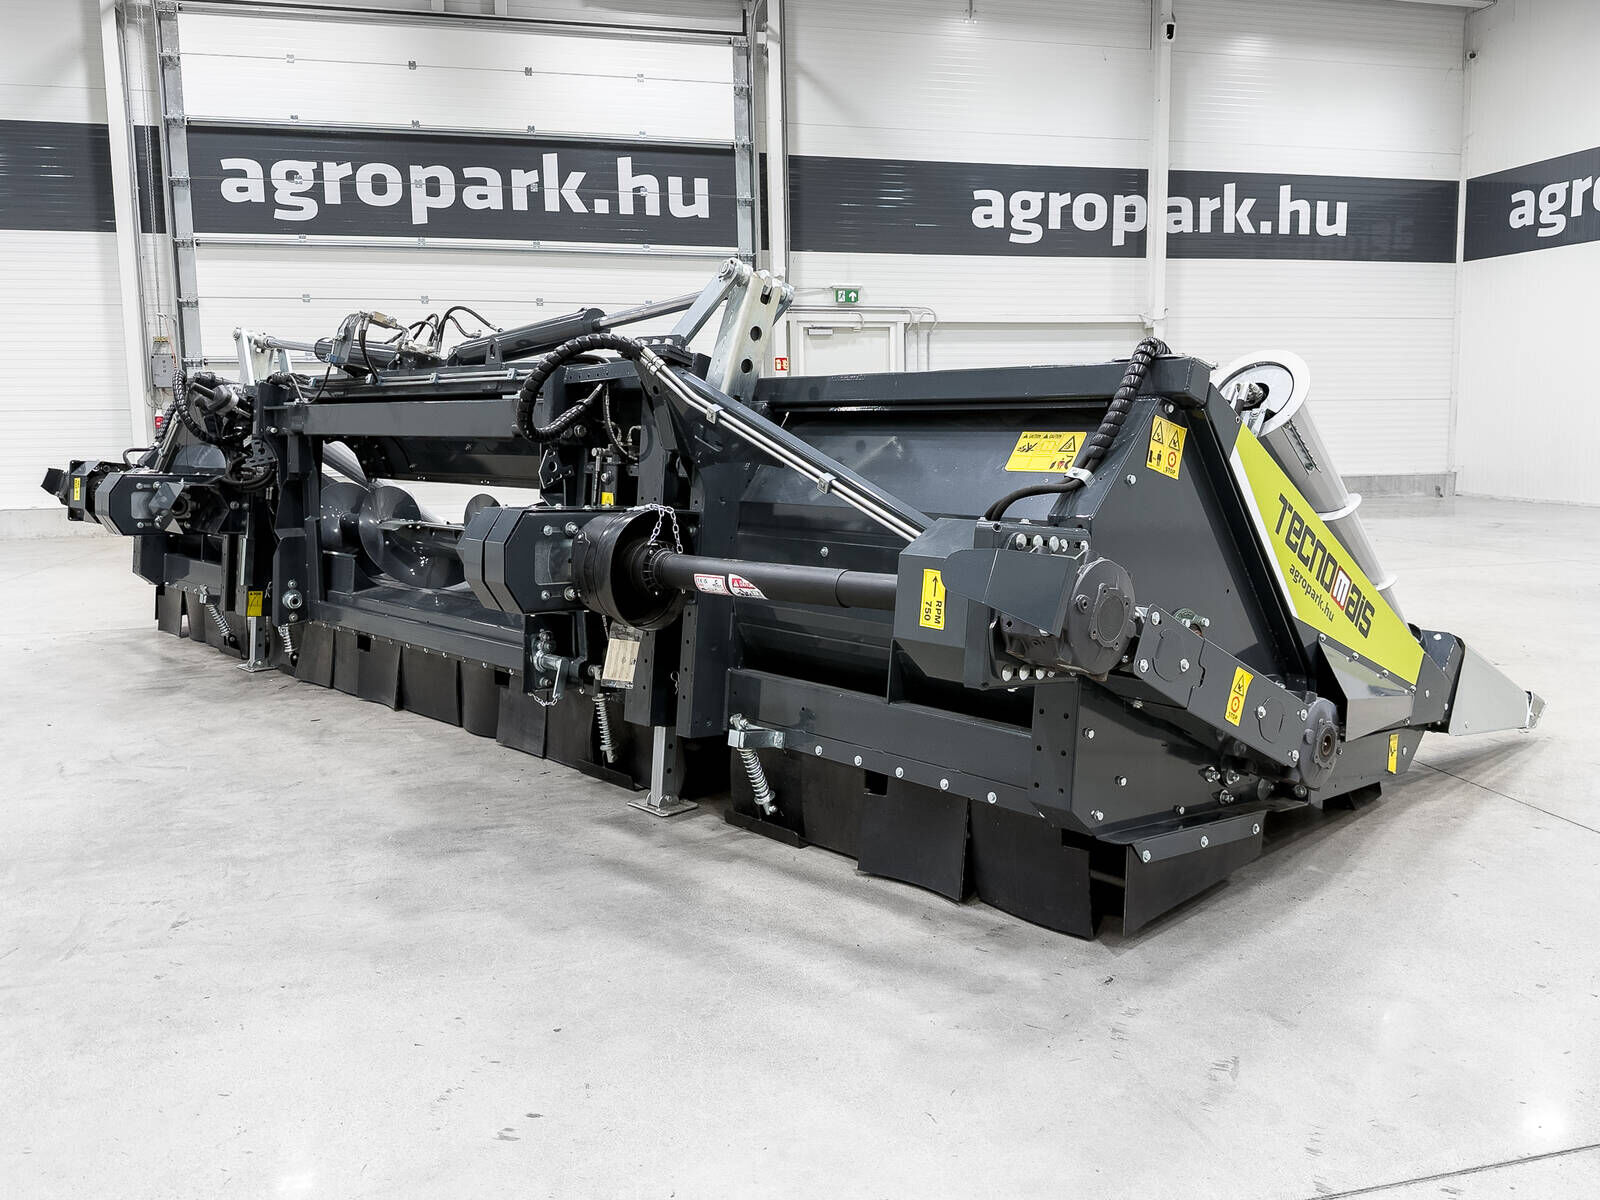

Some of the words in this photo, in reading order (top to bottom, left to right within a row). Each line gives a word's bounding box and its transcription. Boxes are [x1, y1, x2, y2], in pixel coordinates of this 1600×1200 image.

[219, 152, 710, 225] agropark.hu
[971, 182, 1349, 246] agropark.hu
[1509, 175, 1600, 237] agr
[924, 601, 932, 621] 750
[934, 600, 942, 624] RPM
[1289, 563, 1335, 622] agropark.hu
